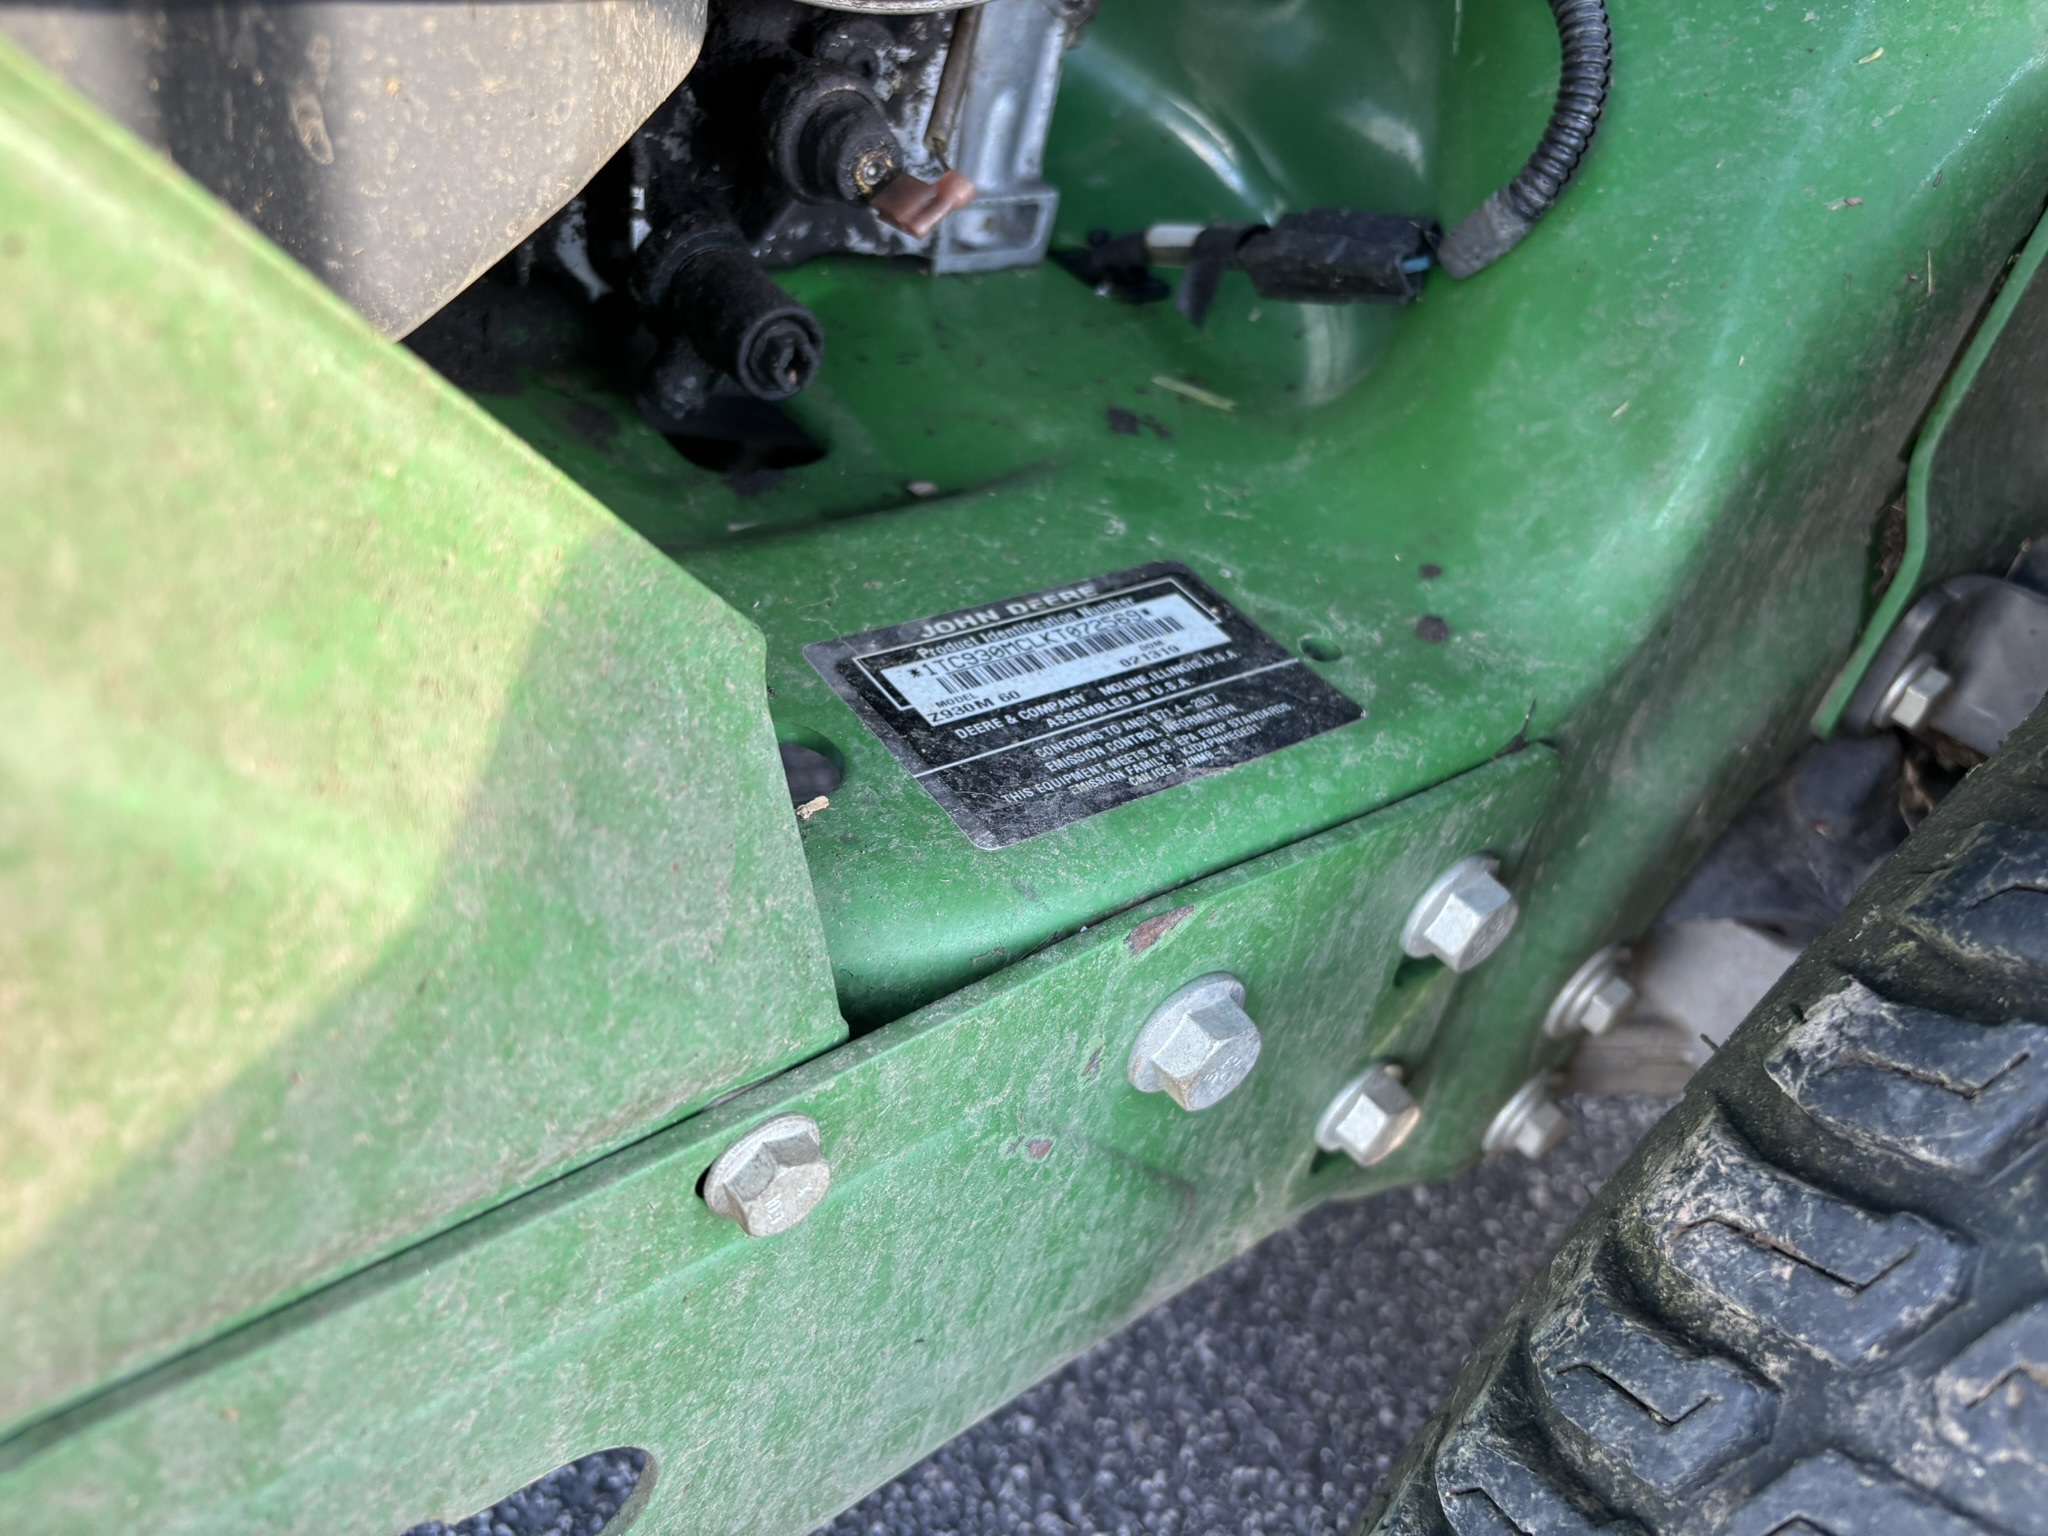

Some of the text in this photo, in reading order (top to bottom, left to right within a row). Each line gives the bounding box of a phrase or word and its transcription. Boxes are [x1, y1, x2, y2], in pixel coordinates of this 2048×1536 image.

[917, 585, 1099, 637] JOHN DEERE
[917, 596, 1136, 658] Product Identification Number
[927, 690, 1021, 722] Z930M 60
[936, 692, 977, 707] MODEL
[955, 718, 1004, 738] DEERE
[1003, 714, 1019, 724] &
[1017, 693, 1087, 720] COMPANY
[1045, 676, 1194, 727] ASSEMBLED IN U.S.A.
[1034, 730, 1103, 757] CONFORMS
[1102, 724, 1122, 735] TO
[1121, 715, 1151, 729] ANSI
[1045, 746, 1105, 771] EMISSION
[1105, 728, 1162, 752] CONTROL
[1002, 788, 1034, 803] THIS
[1035, 763, 1105, 793] EQUIPMENT
[1106, 749, 1149, 768] MEETS
[1148, 740, 1175, 754] U.S.
[1175, 732, 1200, 744] EPA
[1198, 721, 1230, 737] EVAP
[1068, 769, 1124, 794] EMISSION
[1124, 752, 1173, 774] FAMILY:
[1129, 773, 1152, 785] CAN
